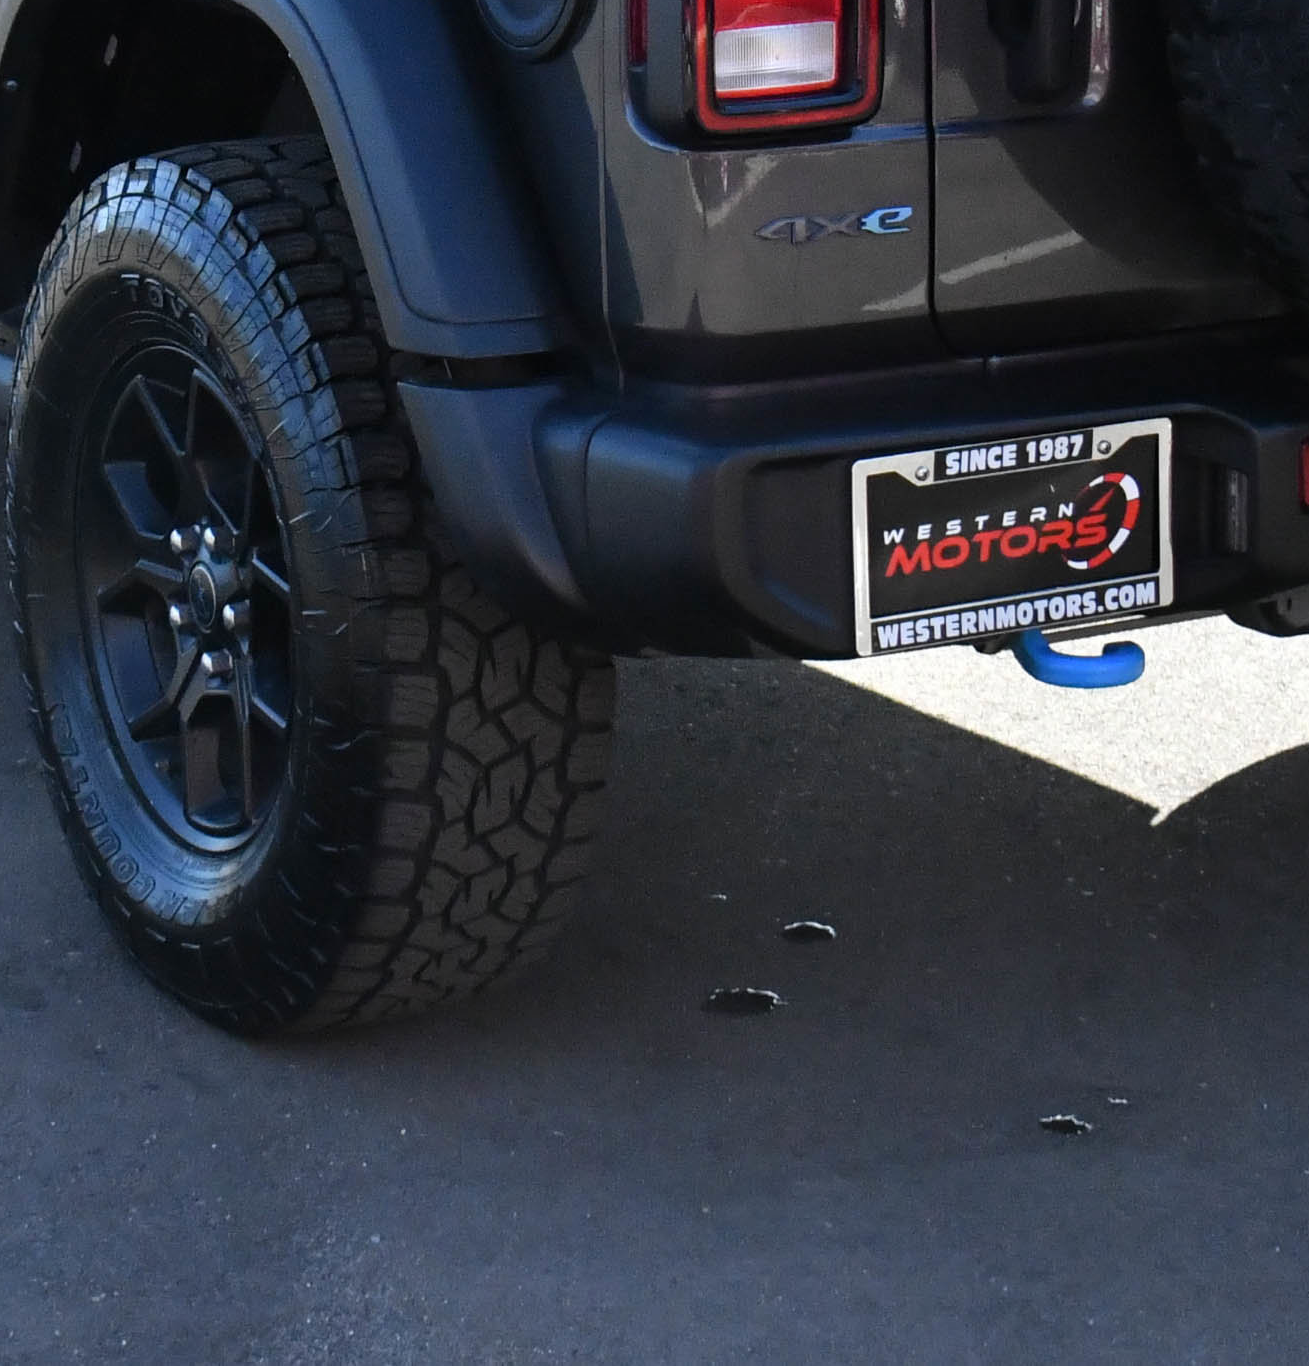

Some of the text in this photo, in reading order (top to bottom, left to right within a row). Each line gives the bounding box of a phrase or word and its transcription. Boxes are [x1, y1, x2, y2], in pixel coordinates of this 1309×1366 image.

[945, 433, 1085, 477] SINCE 1987
[883, 501, 1075, 546] WESTERN
[885, 513, 1109, 578] MOTORS
[877, 580, 1157, 651] WESTERNMOTORS.COM
